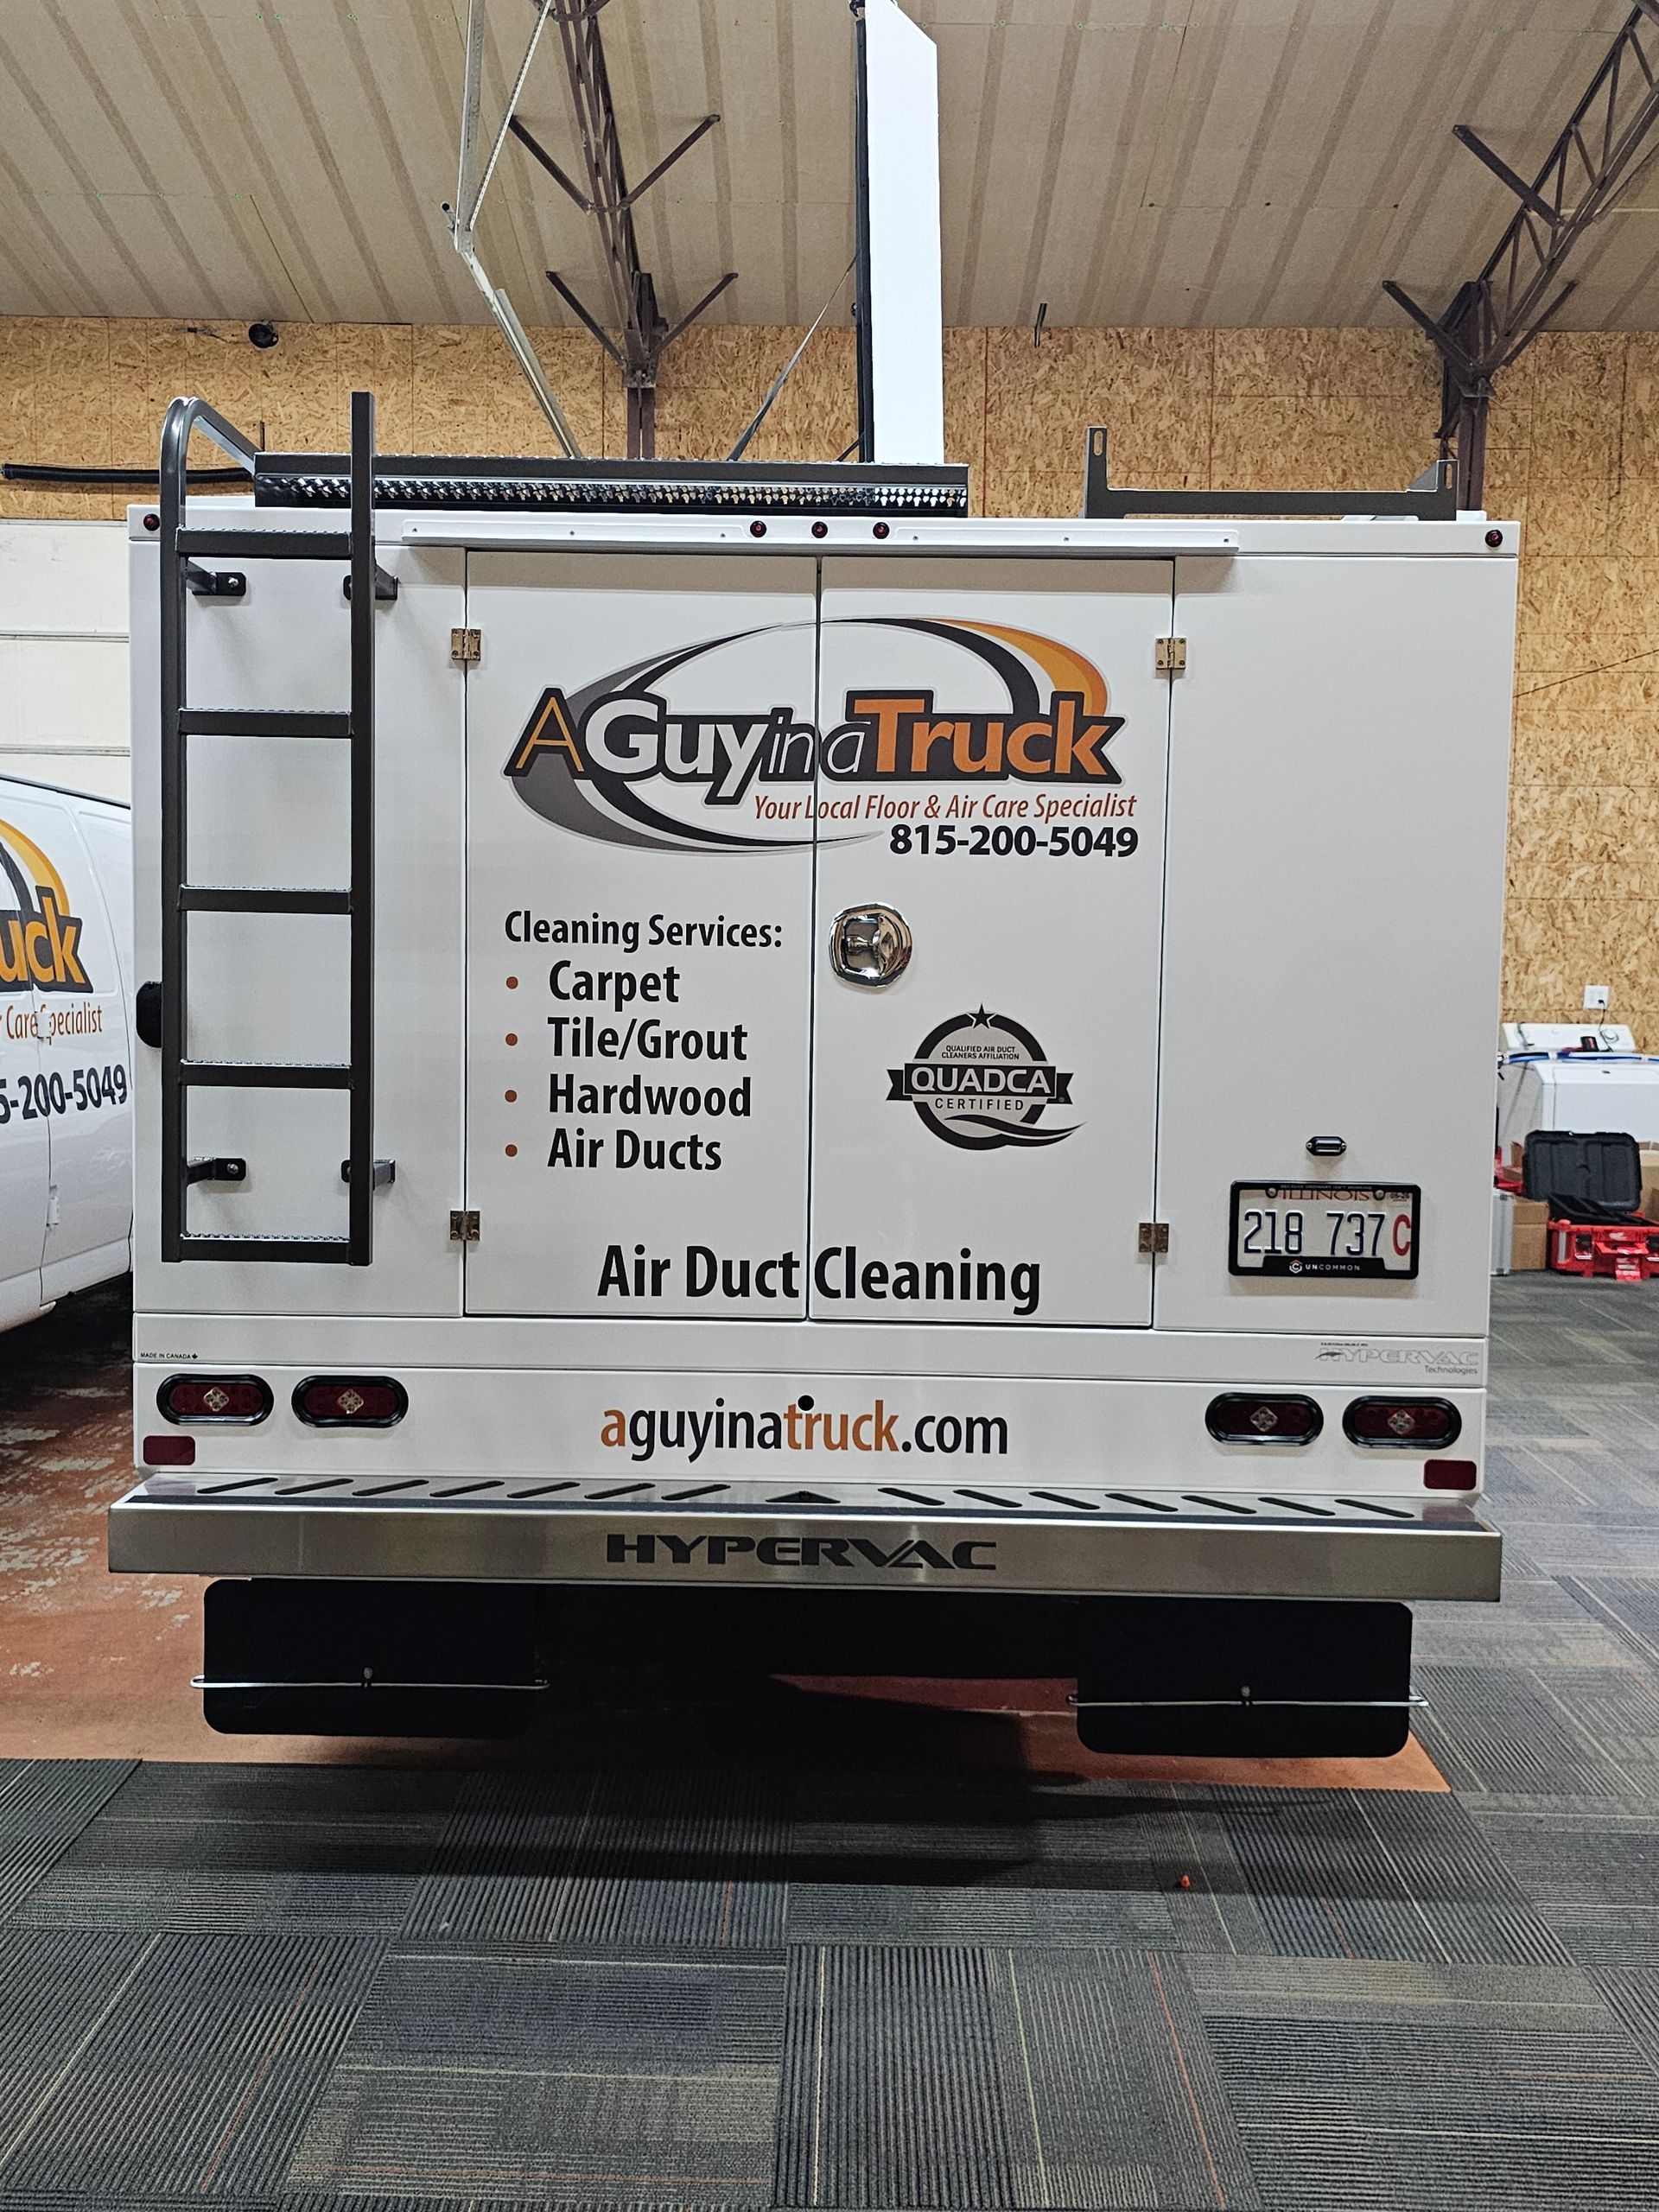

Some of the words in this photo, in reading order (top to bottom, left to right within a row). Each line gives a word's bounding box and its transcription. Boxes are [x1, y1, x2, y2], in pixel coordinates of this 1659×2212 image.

[754, 795, 802, 819] Your
[804, 795, 859, 819] Local
[866, 794, 919, 819] Floor
[925, 795, 942, 819] &
[946, 794, 977, 819] Air
[982, 794, 1028, 819] Care
[1034, 793, 1137, 823] Specialist
[889, 823, 1139, 857] 815-200-5049
[505, 910, 639, 953] Cleaning
[648, 914, 782, 948] Services:
[549, 960, 680, 1012] Carpet
[7, 1005, 37, 1039] Care
[41, 1001, 103, 1046] pecialist
[547, 1016, 748, 1061] Tile/Grout
[549, 1073, 752, 1117] Hardwood
[911, 1066, 1052, 1094] QUADCA
[935, 1097, 1024, 1110] CERTIFIED
[547, 1128, 604, 1168] Air
[615, 1129, 722, 1171] Ducts
[1282, 1190, 1370, 1201] ILLINOIS
[1243, 1211, 1304, 1255] 218
[1326, 1212, 1386, 1256] 737
[1392, 1214, 1411, 1256] C
[597, 1244, 671, 1297] Air
[686, 1245, 800, 1298] Duct
[814, 1246, 1040, 1315] Cleaning
[1319, 1347, 1479, 1365] HYPERVAC
[1425, 1365, 1478, 1376] Technologies
[601, 1397, 1008, 1463] aguyinatruck.com
[607, 1534, 996, 1571] HYPERVAC
